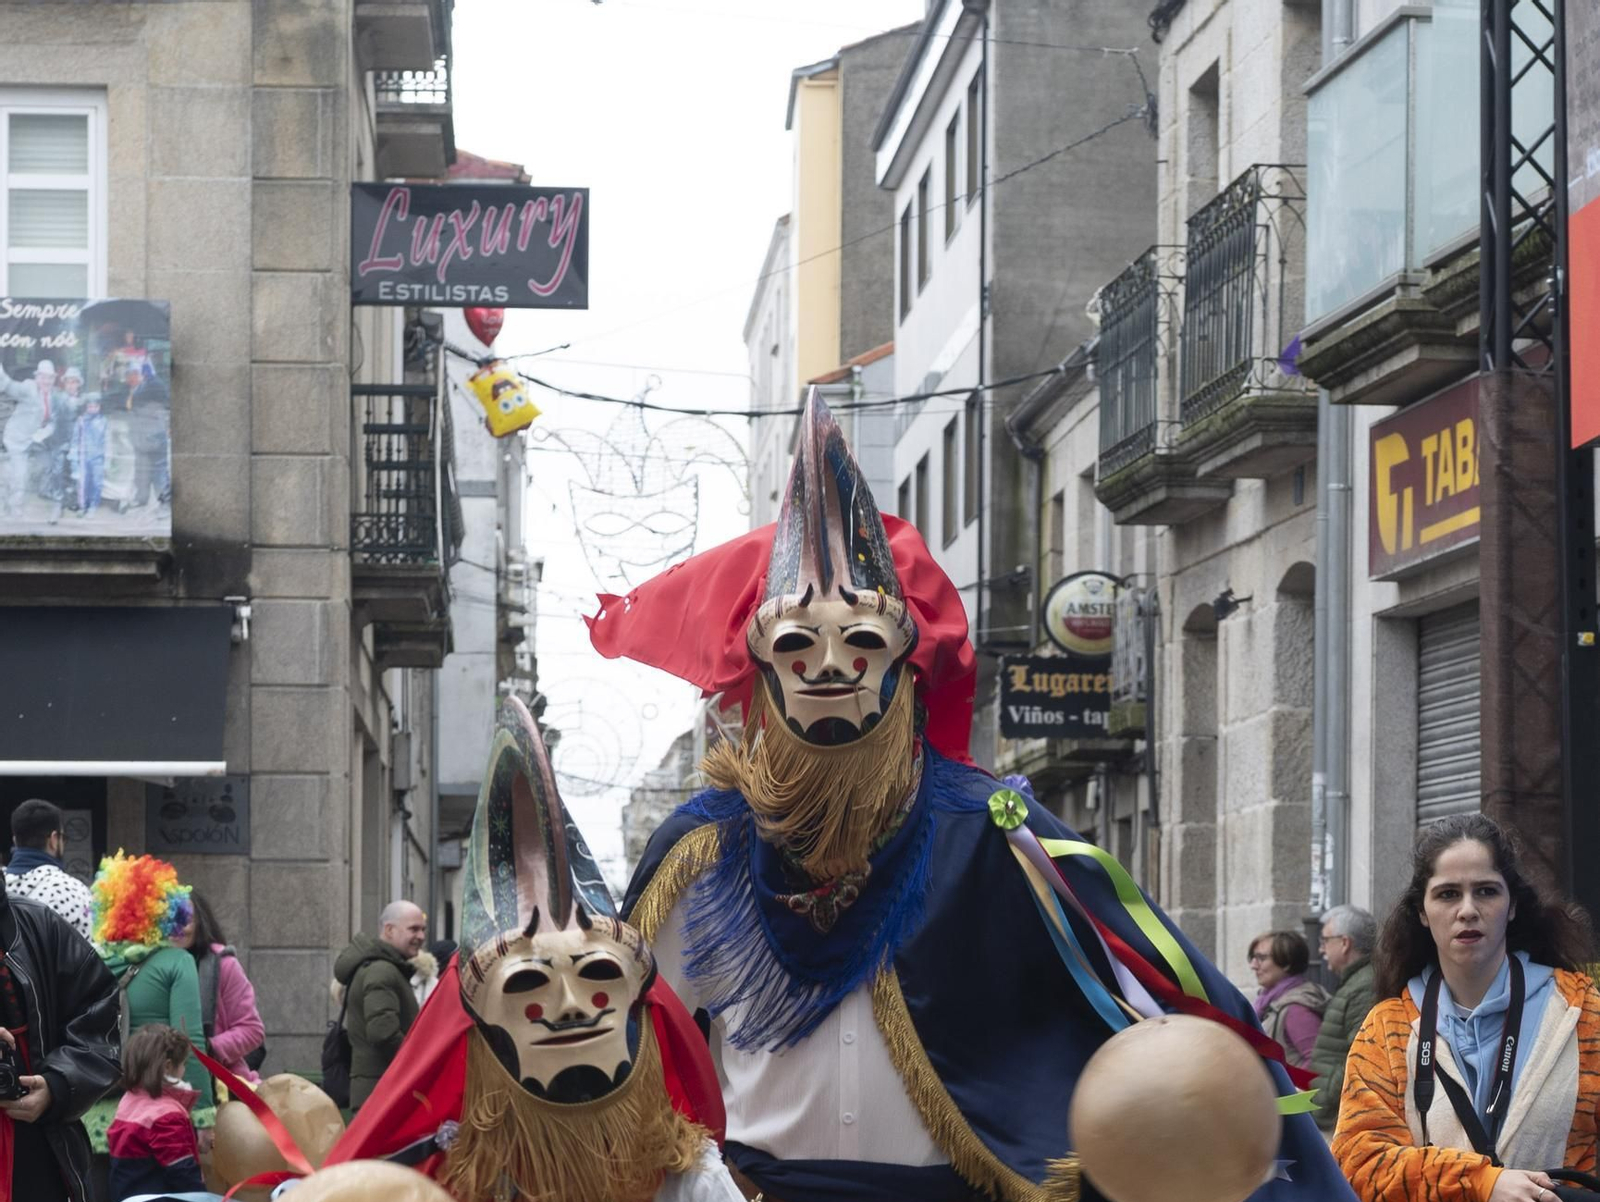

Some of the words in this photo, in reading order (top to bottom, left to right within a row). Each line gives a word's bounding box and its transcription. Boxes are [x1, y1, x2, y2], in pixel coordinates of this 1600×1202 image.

[358, 187, 584, 297] Luxury
[378, 281, 510, 302] ESTILISTAS
[0, 298, 82, 327] Sempre
[0, 332, 37, 348] con
[40, 330, 79, 348] nós
[1421, 417, 1480, 506] TAB
[1008, 704, 1065, 725] Viños
[1421, 1041, 1431, 1066] EOS
[1501, 1035, 1515, 1073] Canon
